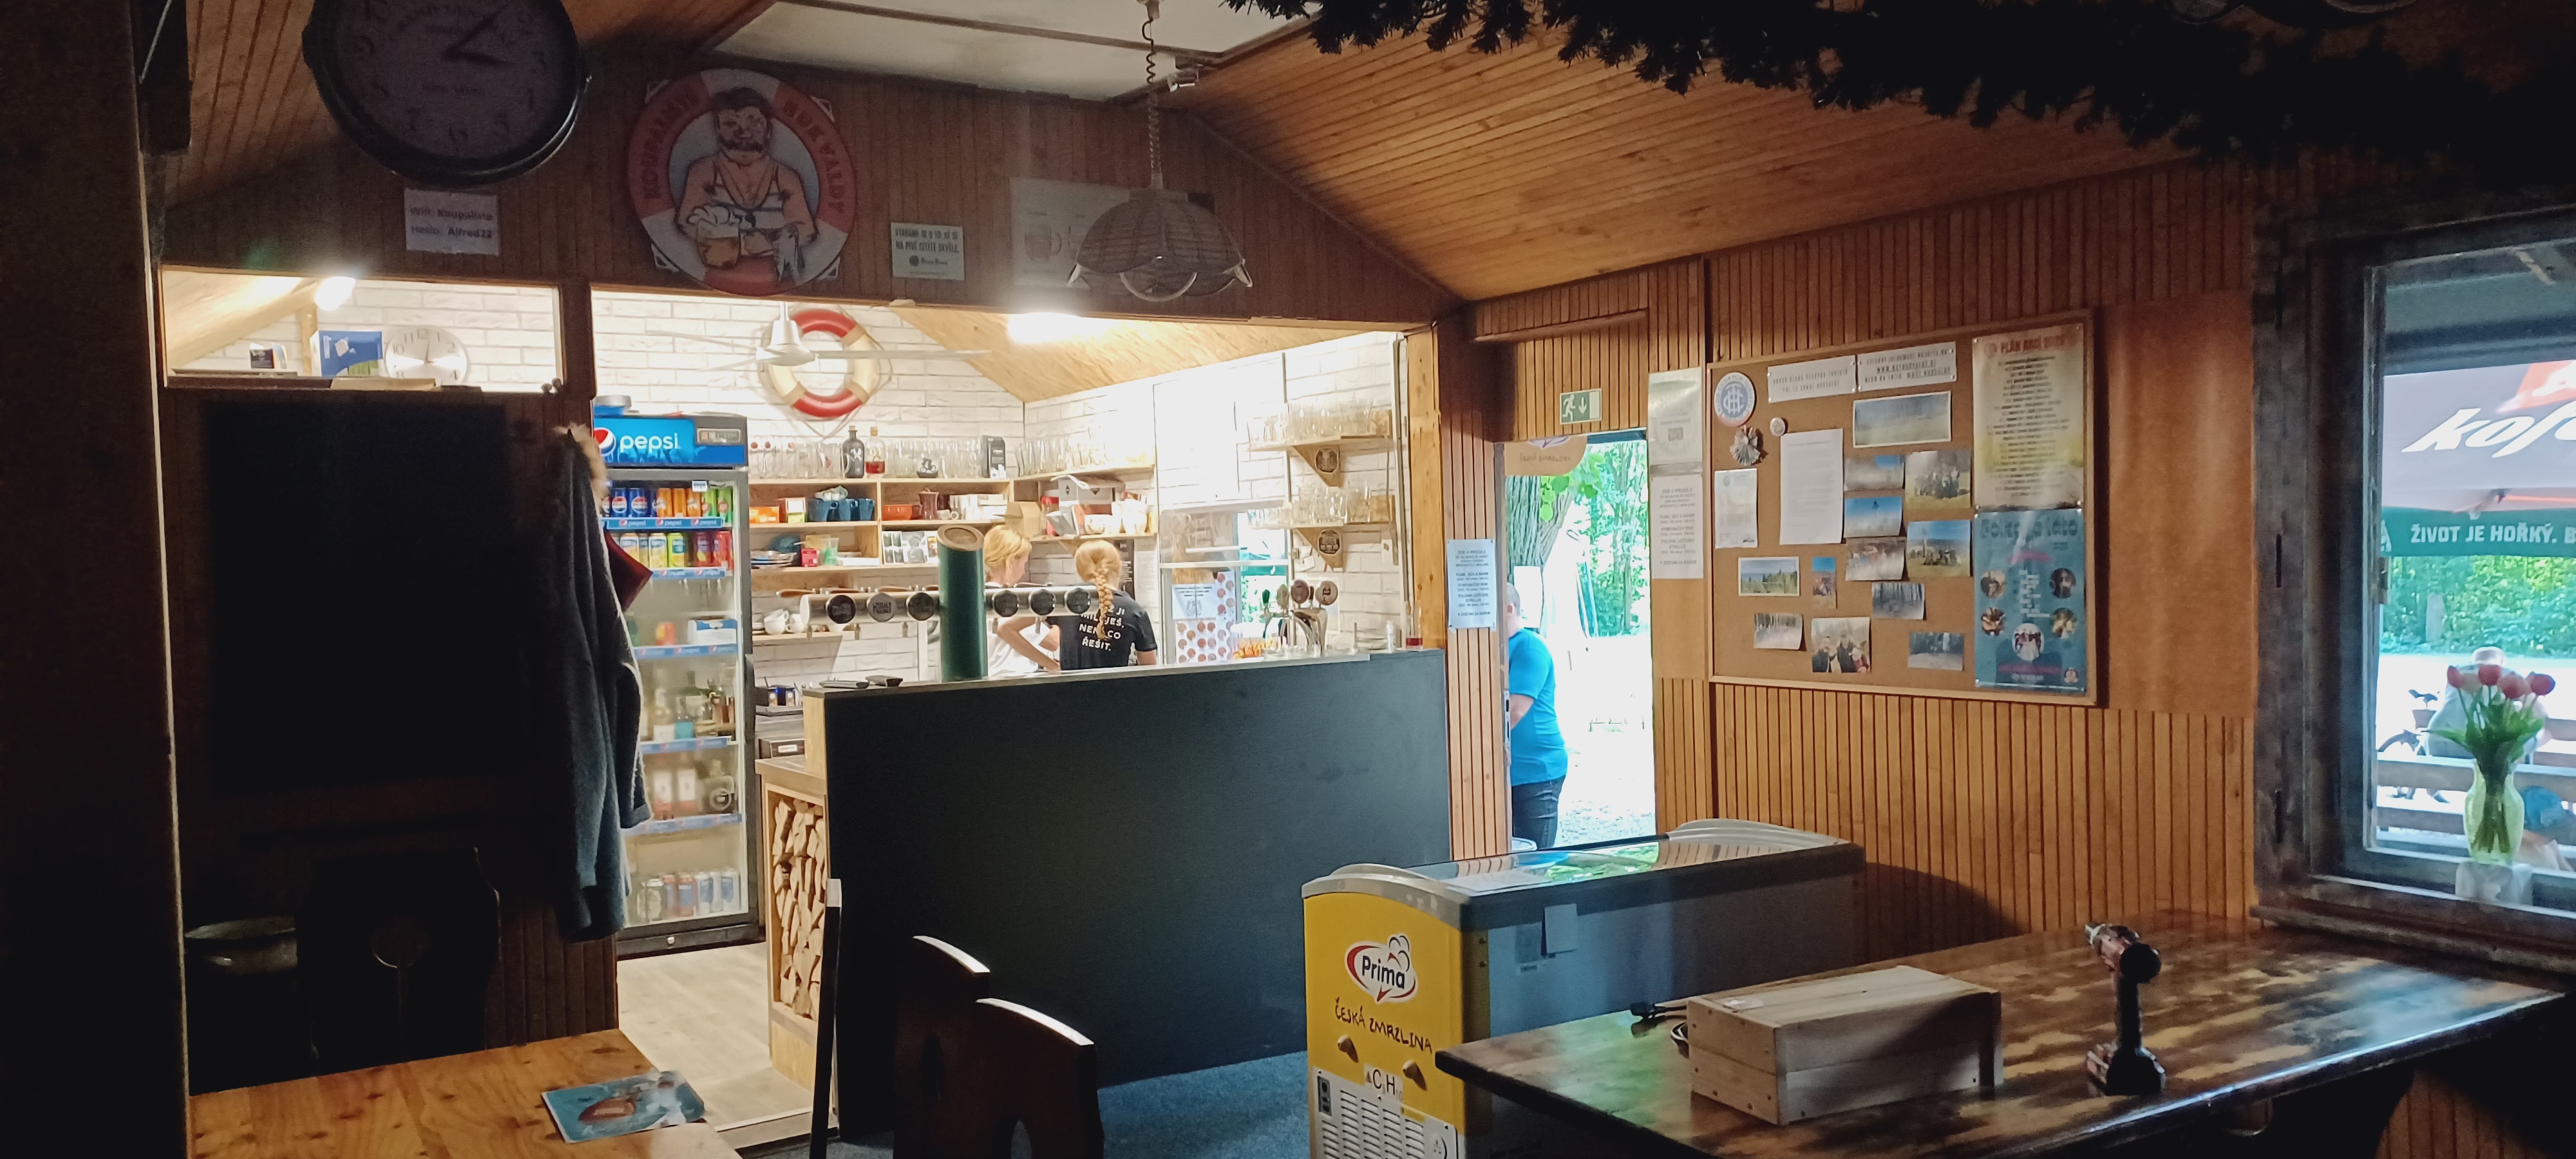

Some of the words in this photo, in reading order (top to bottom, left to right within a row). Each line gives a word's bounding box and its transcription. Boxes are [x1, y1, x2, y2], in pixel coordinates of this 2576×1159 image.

[620, 432, 679, 453] pepsi
[2411, 522, 2461, 543] ŽIVOT
[2465, 524, 2486, 542] JE
[2490, 522, 2557, 544] HOŘKÝ.
[1116, 607, 1125, 616] JI
[1080, 614, 1124, 628] MILJEŠ,
[1107, 630, 1121, 639] CO
[1082, 636, 1112, 652] ŘEŠIT.
[1362, 955, 1405, 990] Prima
[1335, 997, 1366, 1028] ČESKÁ
[1369, 1017, 1433, 1055] ZMRZLINA
